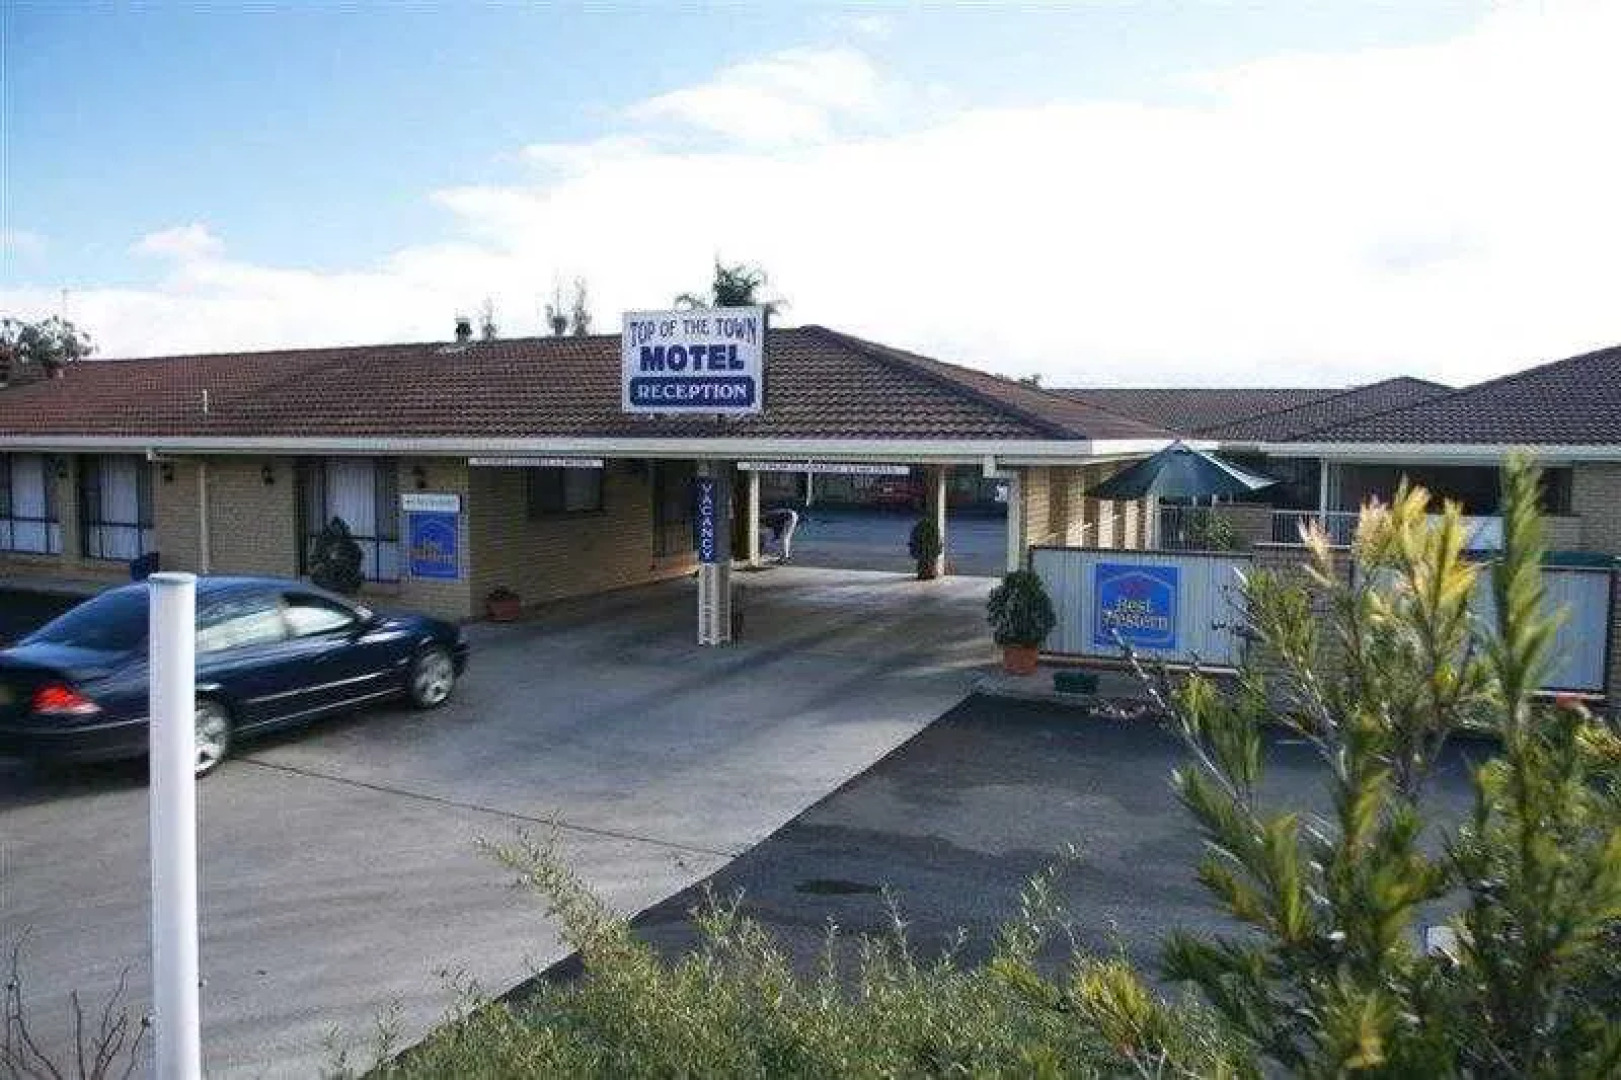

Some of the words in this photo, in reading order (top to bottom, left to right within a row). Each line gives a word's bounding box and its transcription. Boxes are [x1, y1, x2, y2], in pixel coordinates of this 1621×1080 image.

[630, 320, 655, 346] TOP
[660, 320, 677, 337] OF
[683, 319, 709, 334] THE
[715, 317, 757, 345] TOWN
[640, 344, 744, 371] MOTEL
[637, 384, 747, 399] RECEPTION
[701, 483, 712, 559] VACANCY
